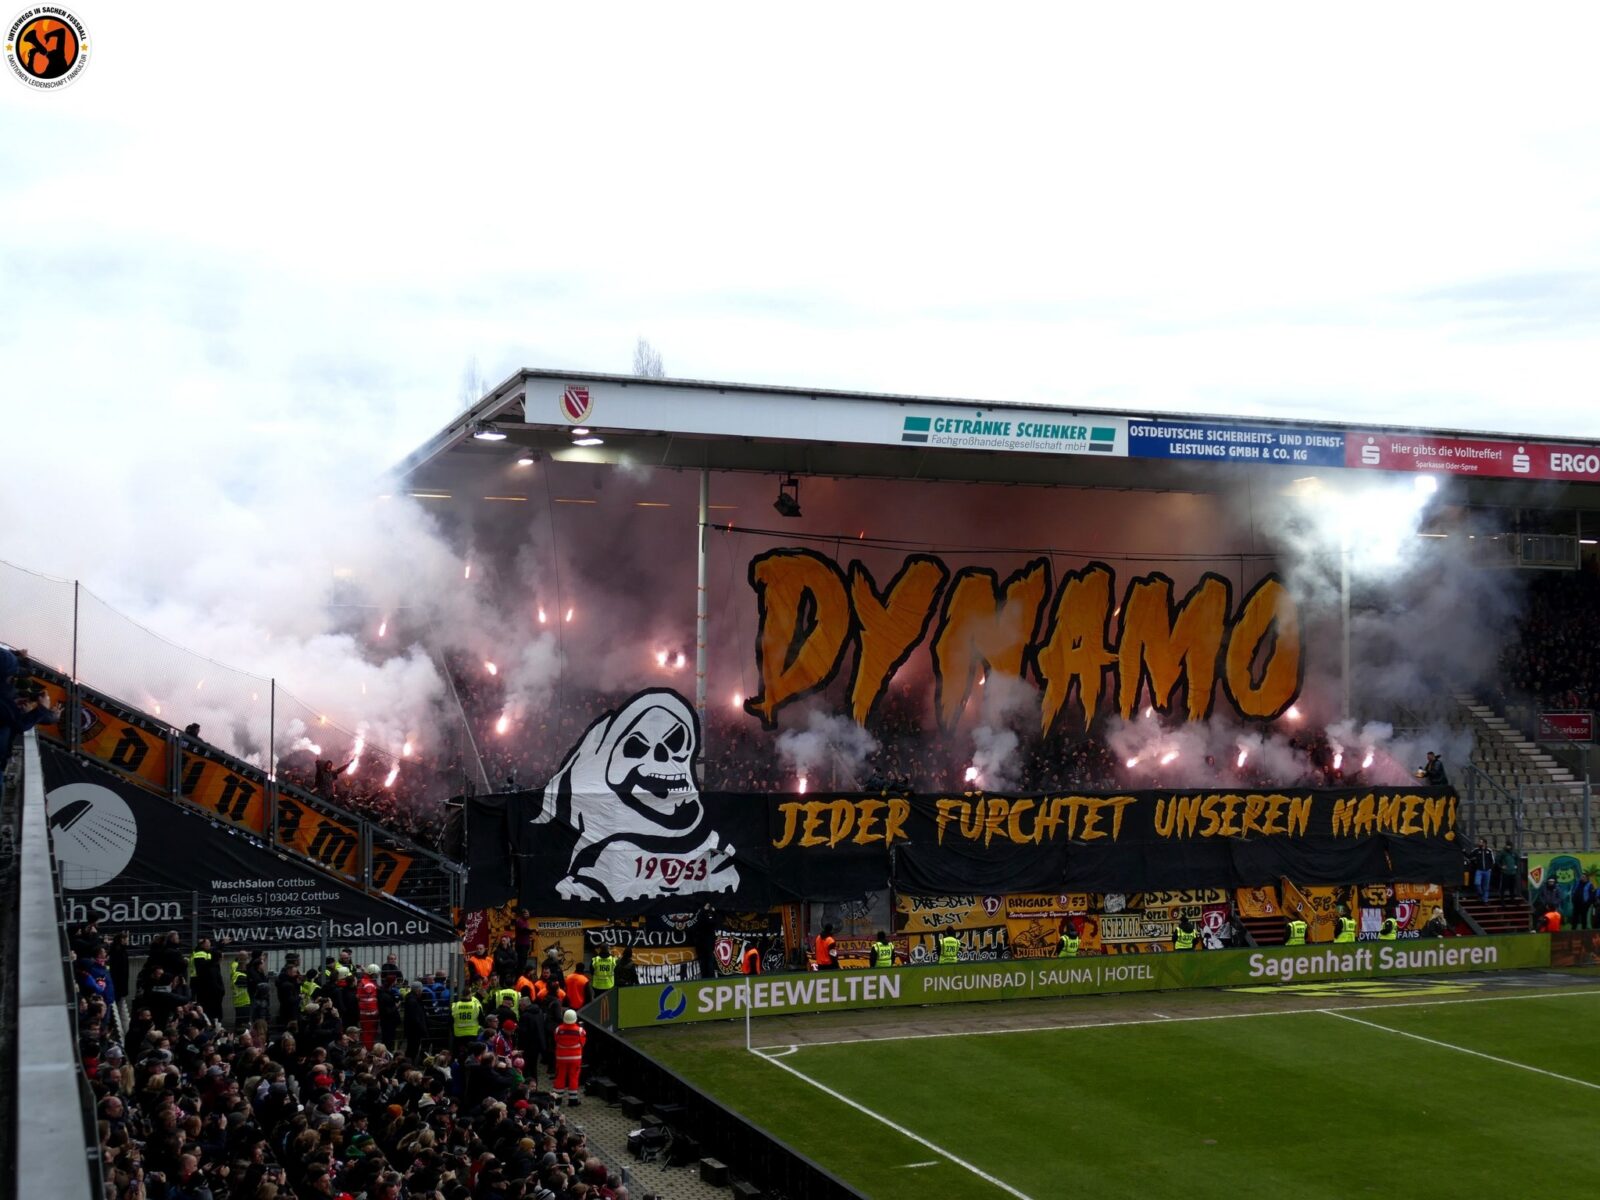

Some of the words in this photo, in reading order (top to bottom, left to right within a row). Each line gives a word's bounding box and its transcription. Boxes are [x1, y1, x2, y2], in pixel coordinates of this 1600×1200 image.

[1016, 422, 1087, 440] SCHENKER
[1130, 425, 1204, 440] OSTDEUTSCHE
[1207, 430, 1276, 444] SICHERHEITS-
[1279, 434, 1301, 446] UND
[1305, 435, 1344, 448] DIENST-
[931, 434, 1062, 450] Fachgroßhandelsgesellschaft
[1064, 442, 1086, 451] mbH
[1169, 443, 1226, 457] LEISTUNGS
[1228, 448, 1260, 458] GMBH
[1263, 449, 1270, 458] &
[1273, 449, 1290, 460] CO.
[1294, 450, 1307, 460] KG
[1392, 443, 1410, 454] Hier
[1413, 444, 1436, 457] gibts
[1438, 446, 1452, 457] die
[1455, 447, 1503, 460] Volltreffer!
[1416, 461, 1444, 469] Sparkasse
[1445, 462, 1478, 471] Oder-Spree
[1550, 453, 1600, 474] ERGO
[745, 548, 1303, 738] DYNAMO
[773, 799, 911, 850] JEDER
[935, 790, 1138, 849] FÜRCHTET
[1154, 794, 1313, 840] UNSEREN
[1332, 794, 1457, 841] NAMEN!
[212, 878, 275, 889] WaschSalon
[277, 878, 316, 888] Cottbus
[212, 895, 228, 903] Am
[230, 894, 255, 903] Gleis
[256, 894, 262, 902] 5
[270, 892, 299, 902] 03042
[301, 892, 340, 901] Cottbus
[1009, 897, 1053, 908] BRIGADE
[1072, 896, 1085, 906] 53
[63, 896, 184, 923] hSalon
[212, 908, 230, 918] Tel.
[232, 908, 262, 918] (0355)
[265, 908, 282, 916] 756
[284, 907, 302, 916] 266
[304, 906, 322, 914] 251
[212, 917, 430, 942] www.waschsalon.eu
[1398, 930, 1420, 938] FANS
[1249, 948, 1372, 981] Sagenhaft
[1379, 944, 1497, 970] Saunieren
[924, 972, 1026, 992] PINGUINBAD
[1038, 968, 1092, 986] SAUNA
[1105, 965, 1154, 982] HOTEL
[698, 974, 900, 1013] SPREEWELTEN
